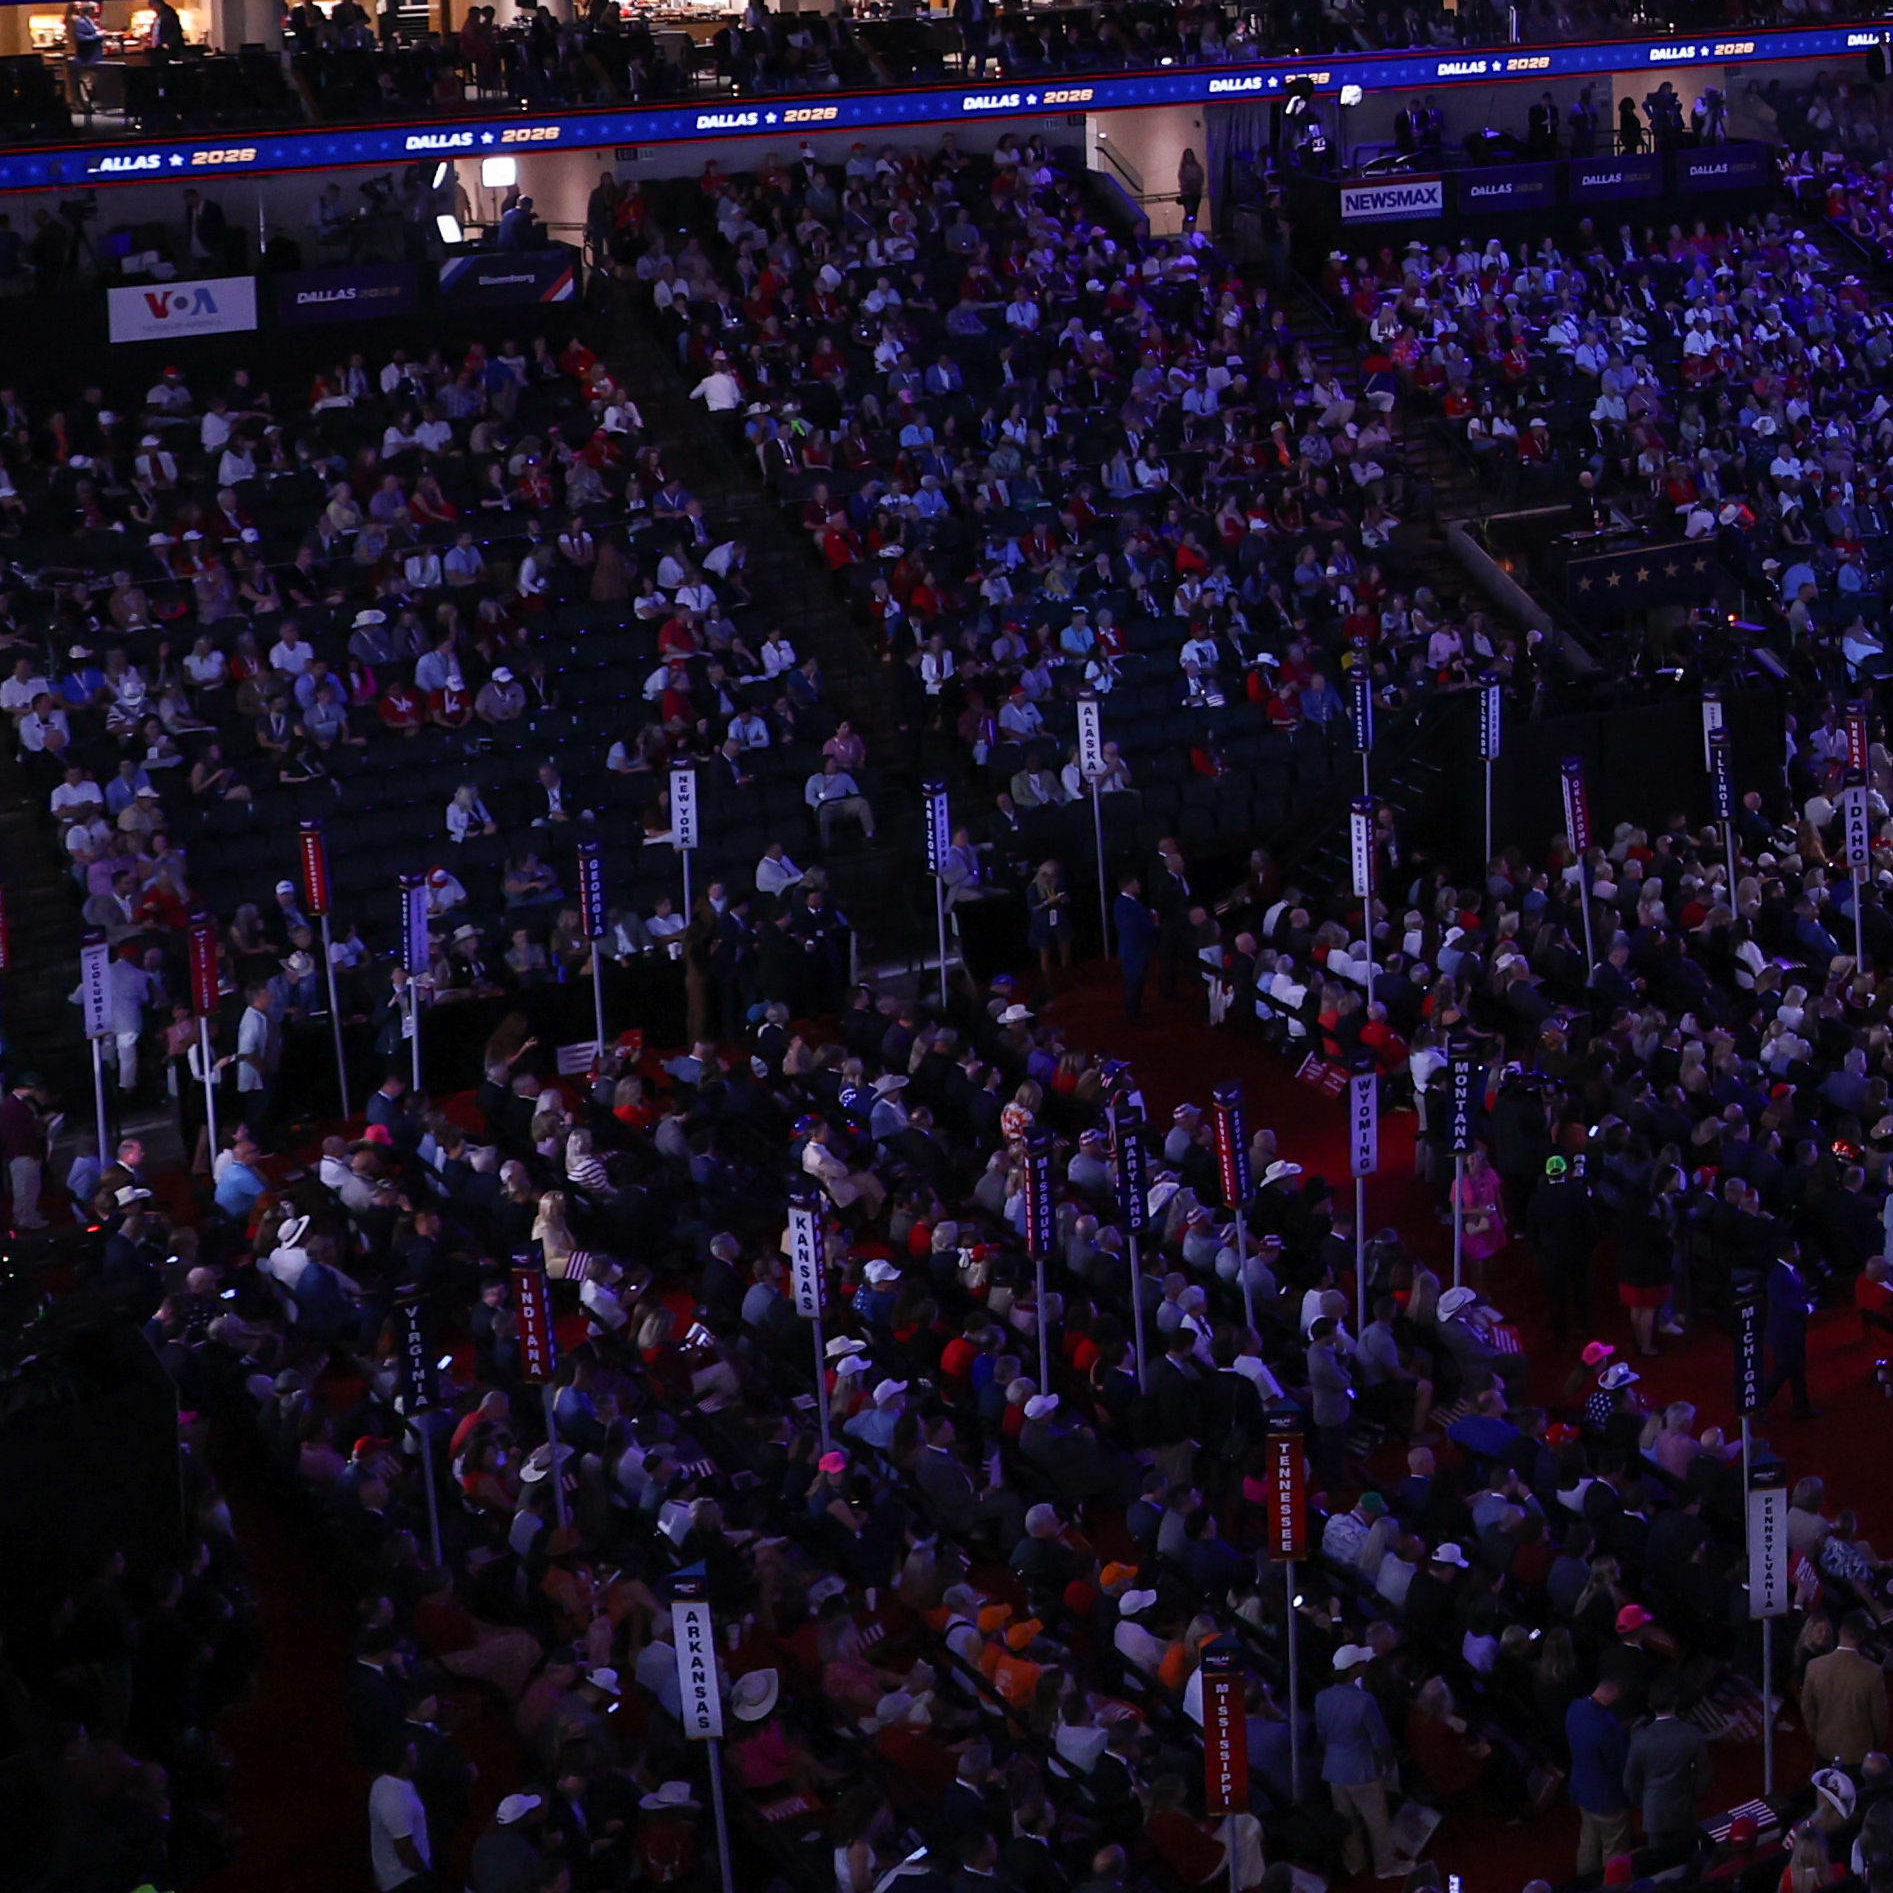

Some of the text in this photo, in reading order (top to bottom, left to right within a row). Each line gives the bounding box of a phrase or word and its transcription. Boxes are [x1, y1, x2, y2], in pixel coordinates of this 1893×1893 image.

[1209, 76, 1262, 93] DALLAS
[1437, 56, 1551, 77] DALLAS 2026
[1650, 42, 1755, 61] DALLAS 2026
[697, 107, 838, 129] DALLAS 2026
[963, 88, 1094, 111] DALLAS 2026
[191, 148, 257, 166] 2026
[405, 126, 560, 151] DALLAS 2026
[1690, 163, 1728, 176] DALLAS
[1346, 188, 1438, 212] NEWSMAX
[1470, 183, 1512, 197] DALLAS
[1582, 173, 1622, 186] DALLAS
[144, 288, 218, 318] VOA
[297, 288, 356, 304] DALLAS
[1084, 706, 1097, 770] ALASKA
[678, 776, 691, 844] NEW YORK
[1573, 780, 1586, 848] OKLAHOMA
[1717, 750, 1728, 818] ILLINOIS
[925, 800, 934, 869] ARIZONA
[1851, 792, 1864, 860] IDAHO
[589, 858, 603, 936] GEORGIA
[91, 963, 104, 1031] COLUMBIA
[1357, 1080, 1371, 1170] WYOMING
[1453, 1061, 1467, 1149] MONTANA
[1036, 1157, 1050, 1251] MISSOURI
[1124, 1135, 1141, 1228] MARYLAND
[796, 1217, 813, 1310] KANSAS
[404, 1305, 428, 1406] VIRGINIA
[521, 1278, 542, 1375] INDIANA
[1741, 1305, 1755, 1407] MICHIGAN
[1278, 1442, 1292, 1552] TENNESSEE
[1764, 1498, 1773, 1607] PENNSYLVANIA
[685, 1611, 710, 1729] ARKANSAS
[1215, 1683, 1232, 1805] MISSISSIPPI
